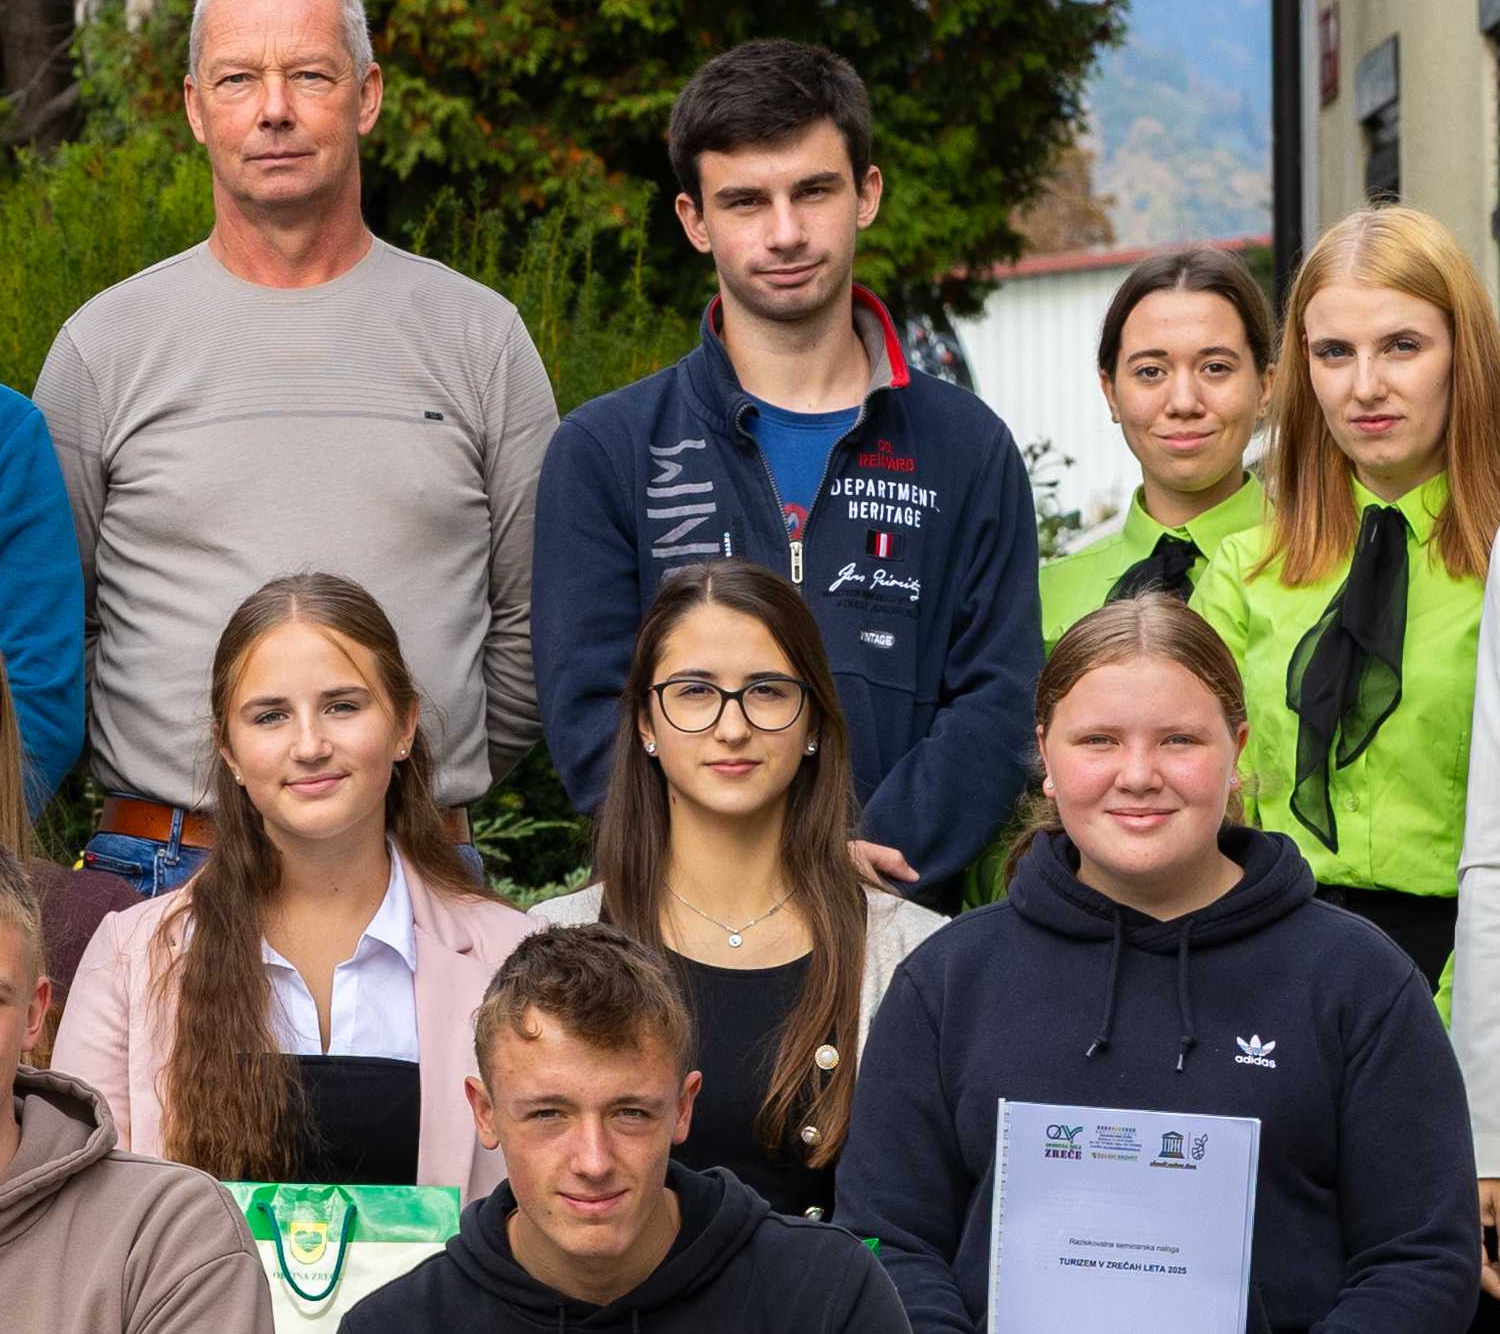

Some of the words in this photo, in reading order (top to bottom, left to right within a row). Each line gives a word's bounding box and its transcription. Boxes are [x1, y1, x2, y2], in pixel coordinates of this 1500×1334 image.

[830, 477, 938, 509] DEPARTMENT
[848, 500, 922, 528] HERITAGE
[1234, 1054, 1277, 1069] adidas
[1044, 1147, 1082, 1161] ZREČE
[1068, 1237, 1115, 1248] Raziskovalna
[1115, 1241, 1155, 1251] seminarska
[1156, 1245, 1180, 1254] naloga
[1058, 1257, 1097, 1267] TURIZEM
[1098, 1260, 1105, 1268] V
[1105, 1259, 1141, 1271] ZREČAH
[1143, 1264, 1166, 1273] LETA
[1167, 1266, 1187, 1275] 2025
